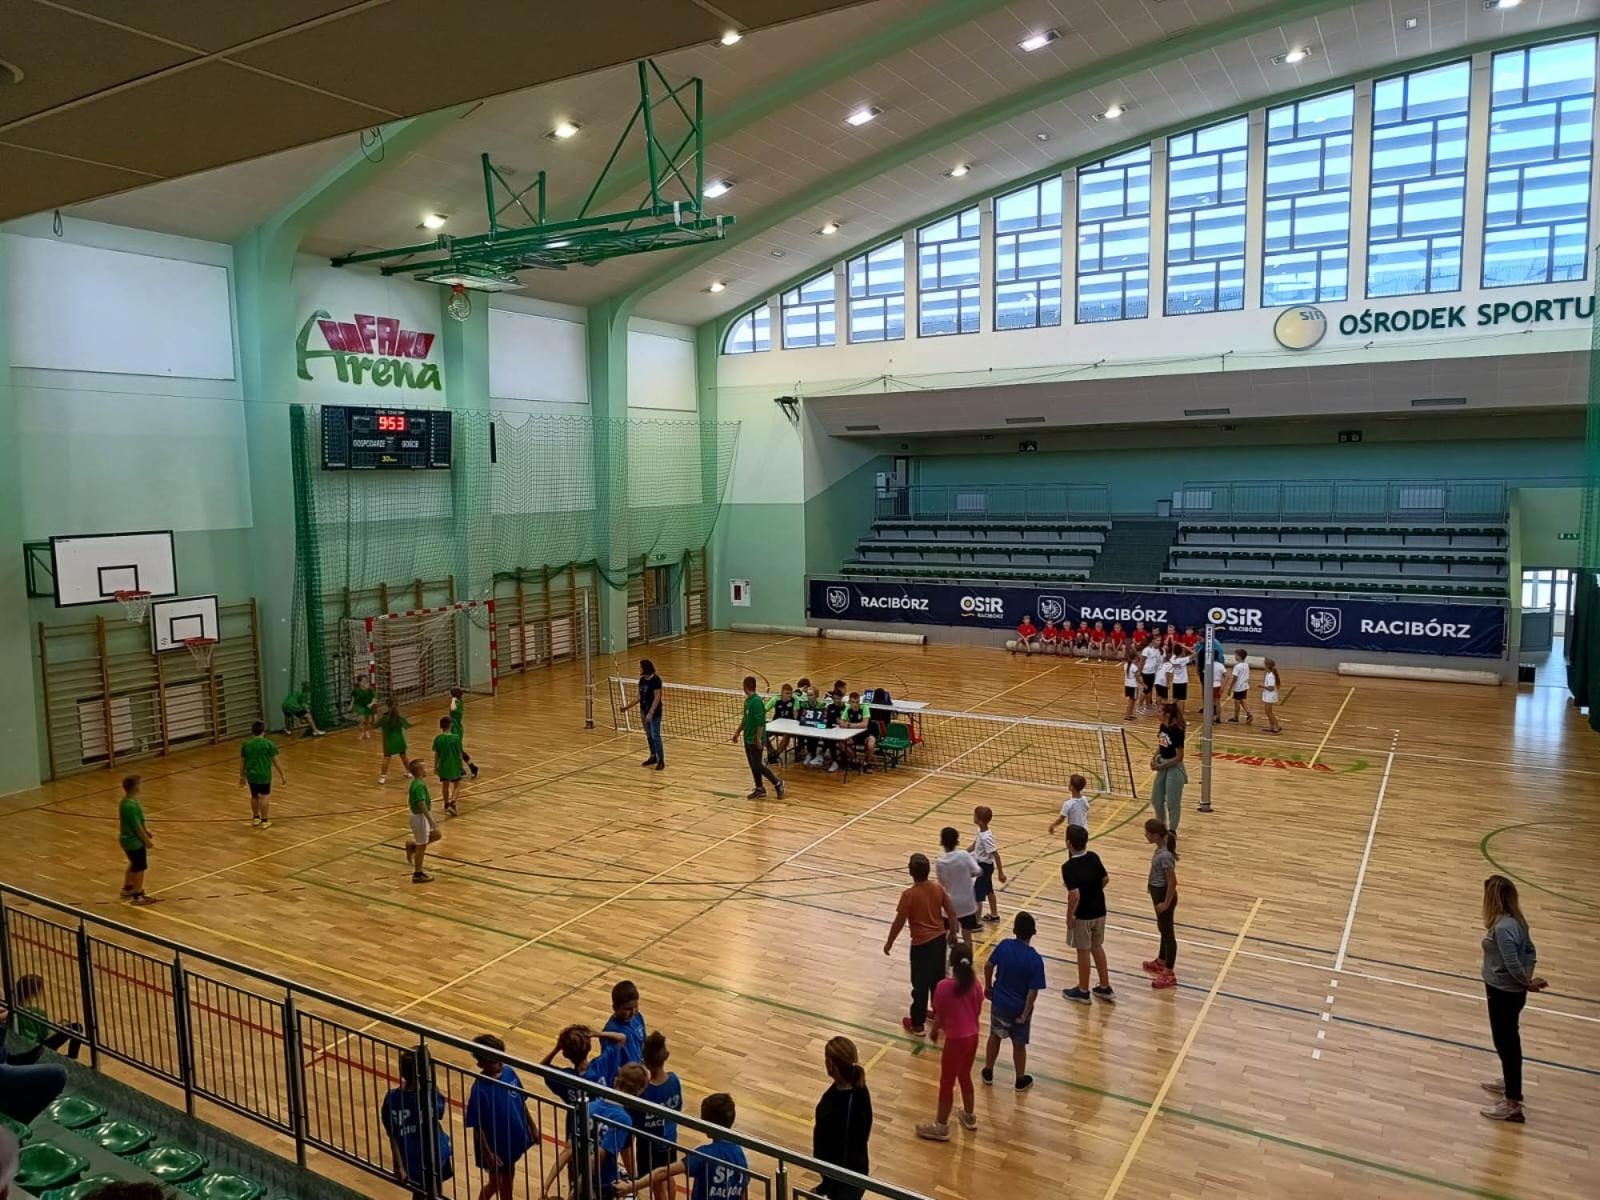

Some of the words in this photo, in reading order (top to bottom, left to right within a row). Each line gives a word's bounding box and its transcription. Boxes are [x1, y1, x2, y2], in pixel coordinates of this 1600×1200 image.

[1339, 305, 1466, 335] OŚRODEK
[1477, 295, 1596, 326] SPORTU
[296, 310, 442, 391] Arena
[860, 594, 929, 610] RACIBÓRZ
[960, 595, 1004, 613] OSiR
[1081, 604, 1168, 623] RACIBÓRZ
[1207, 607, 1263, 627] OSiR
[1360, 617, 1471, 638] RACIBÓRZ
